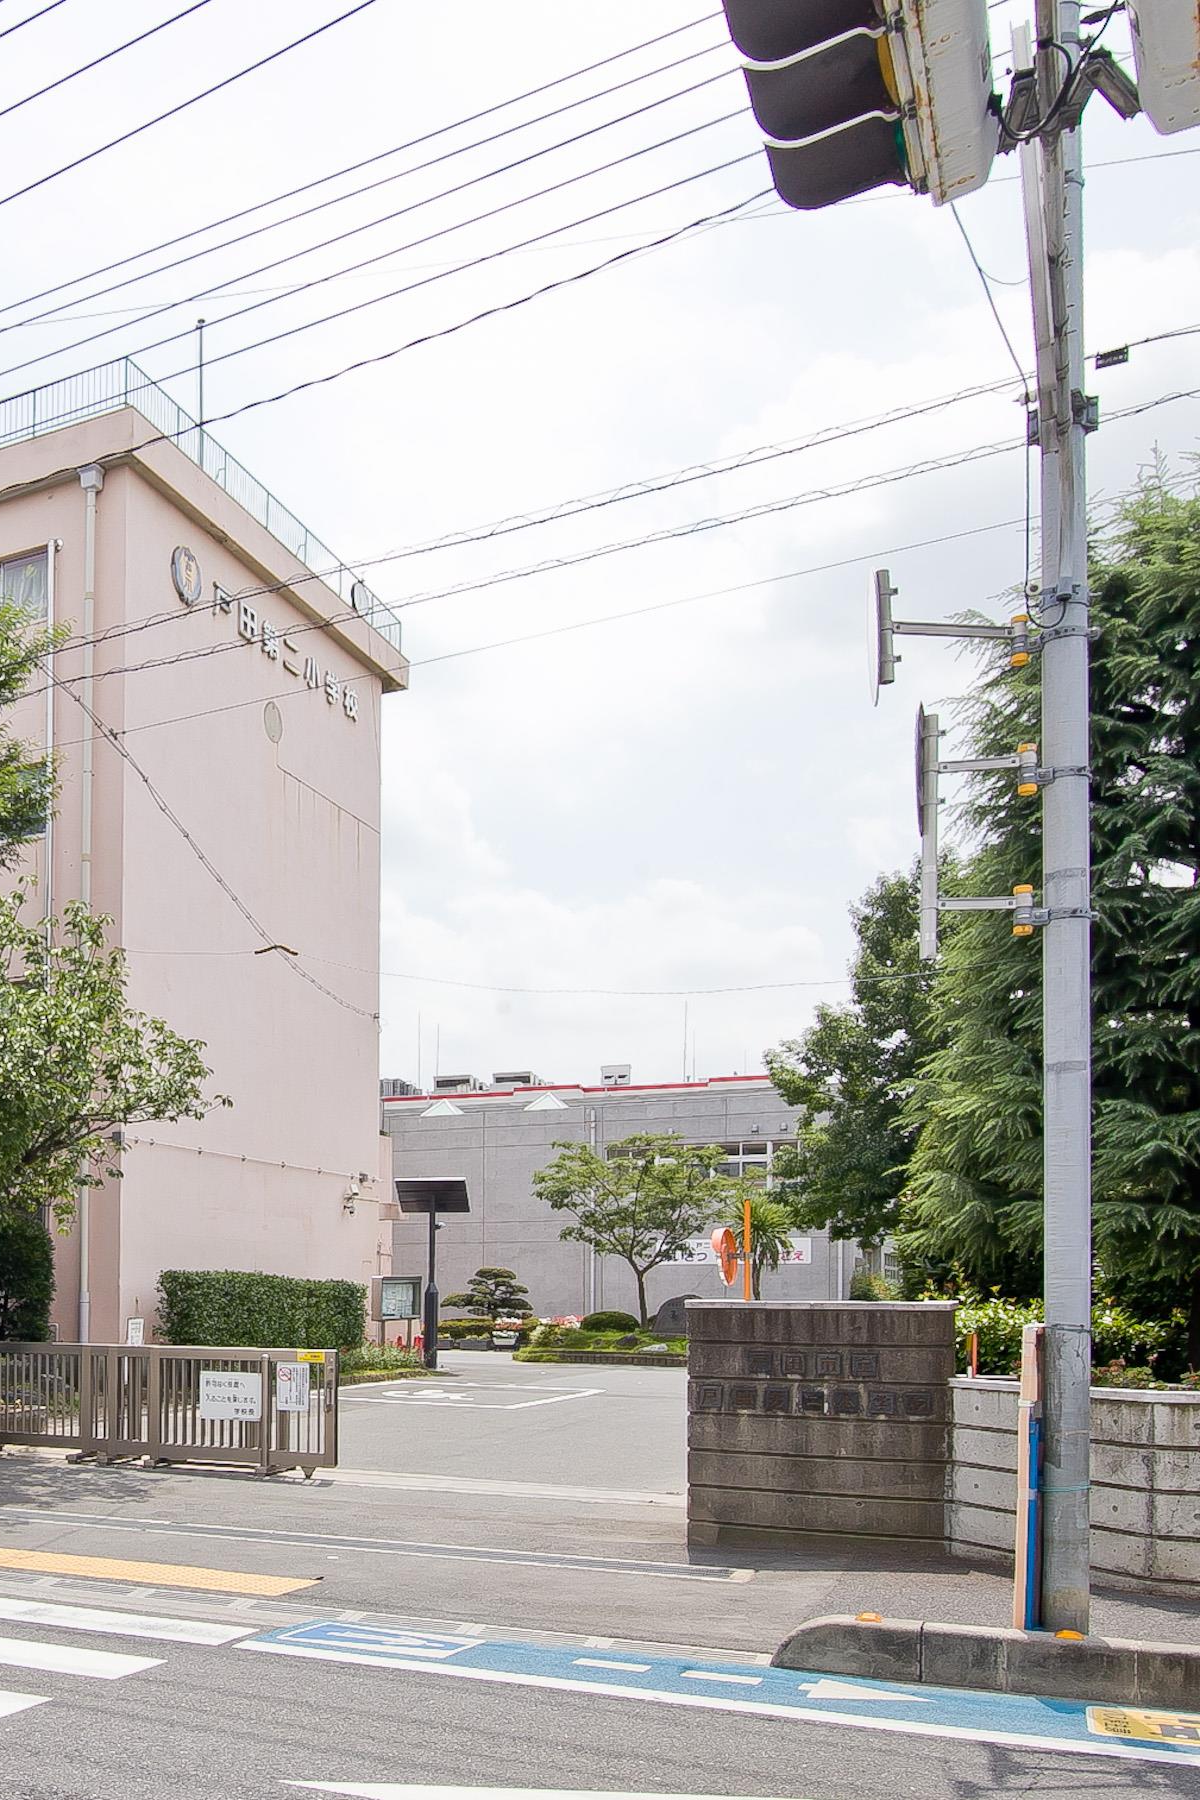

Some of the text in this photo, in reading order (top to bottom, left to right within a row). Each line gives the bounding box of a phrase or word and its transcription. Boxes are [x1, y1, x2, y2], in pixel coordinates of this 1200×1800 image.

[212, 581, 359, 722] 戸田第二小学校
